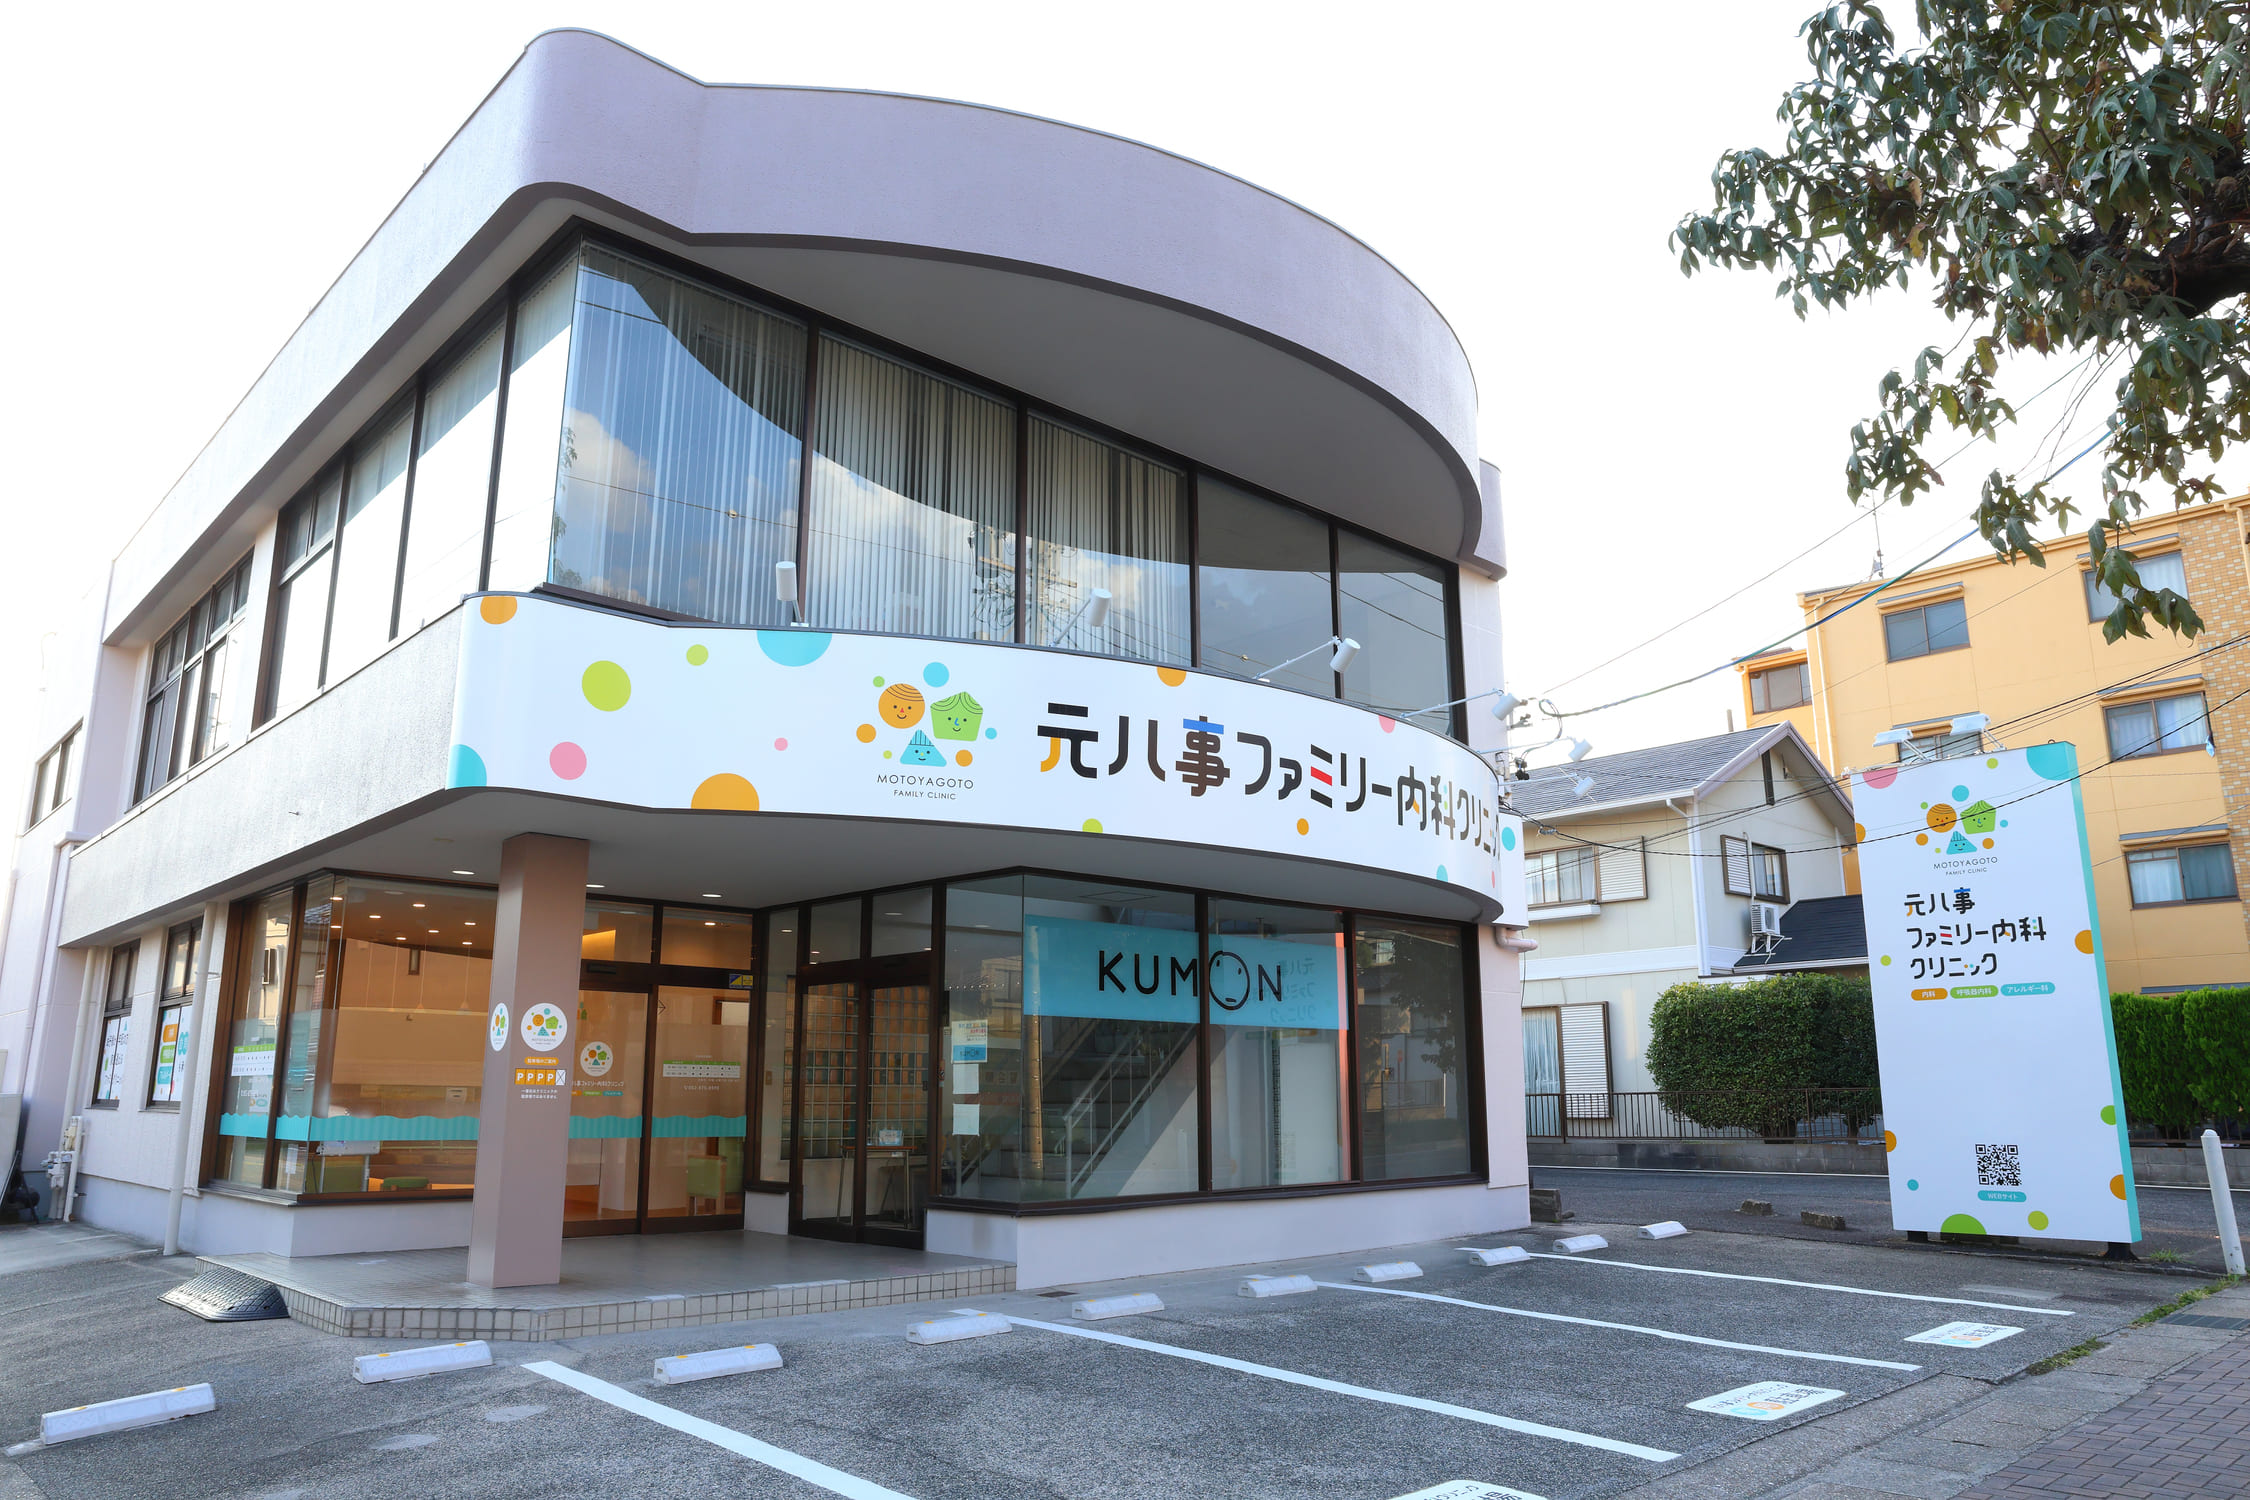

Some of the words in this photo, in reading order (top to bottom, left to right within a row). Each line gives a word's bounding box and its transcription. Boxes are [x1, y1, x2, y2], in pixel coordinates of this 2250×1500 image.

[876, 774, 974, 789] MOTOYAGOTO
[893, 789, 924, 798] FAMILY
[927, 791, 957, 800] CLINIC
[1933, 856, 1998, 870] MOTOYAGOTO
[1967, 866, 1987, 874] CLINIC
[1904, 887, 1975, 917] 元八事
[1906, 916, 2047, 949] ファミリー内科
[1910, 952, 1998, 980] クリニック
[1099, 949, 1283, 1011] KUMON
[1921, 990, 1936, 999] 内科
[1956, 988, 1992, 997] 呼吸器内科
[2006, 983, 2049, 993] アレルギー科
[517, 1072, 524, 1081] P
[527, 1073, 534, 1082] P
[537, 1073, 544, 1082] P
[547, 1073, 554, 1082] P
[1987, 1192, 2018, 1201] WEBサイト
